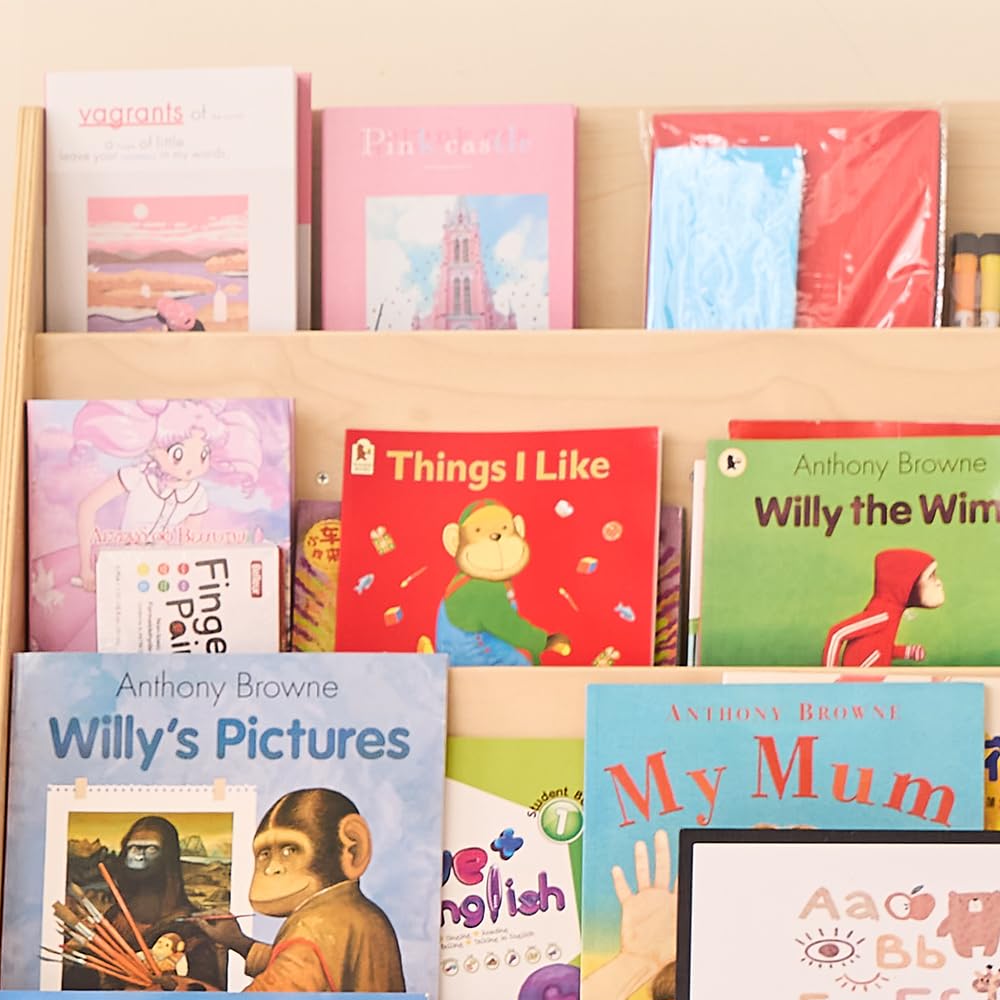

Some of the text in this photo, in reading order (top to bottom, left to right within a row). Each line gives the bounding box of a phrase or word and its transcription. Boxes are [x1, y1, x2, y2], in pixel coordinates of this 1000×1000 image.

[78, 103, 184, 129] vagrants
[360, 124, 532, 157] Pink castle
[386, 449, 610, 491] Things I Like
[794, 451, 987, 480] Anthony Browne
[754, 495, 843, 537] Willy
[850, 494, 912, 525] the
[116, 671, 339, 707] Anthony Browne
[48, 715, 411, 771] Willy's Pictures
[603, 750, 728, 828] My
[751, 735, 956, 828] Mum
[527, 787, 569, 818] Student
[556, 808, 569, 835] 1
[798, 886, 880, 921] Aa
[876, 934, 946, 970] Bb
